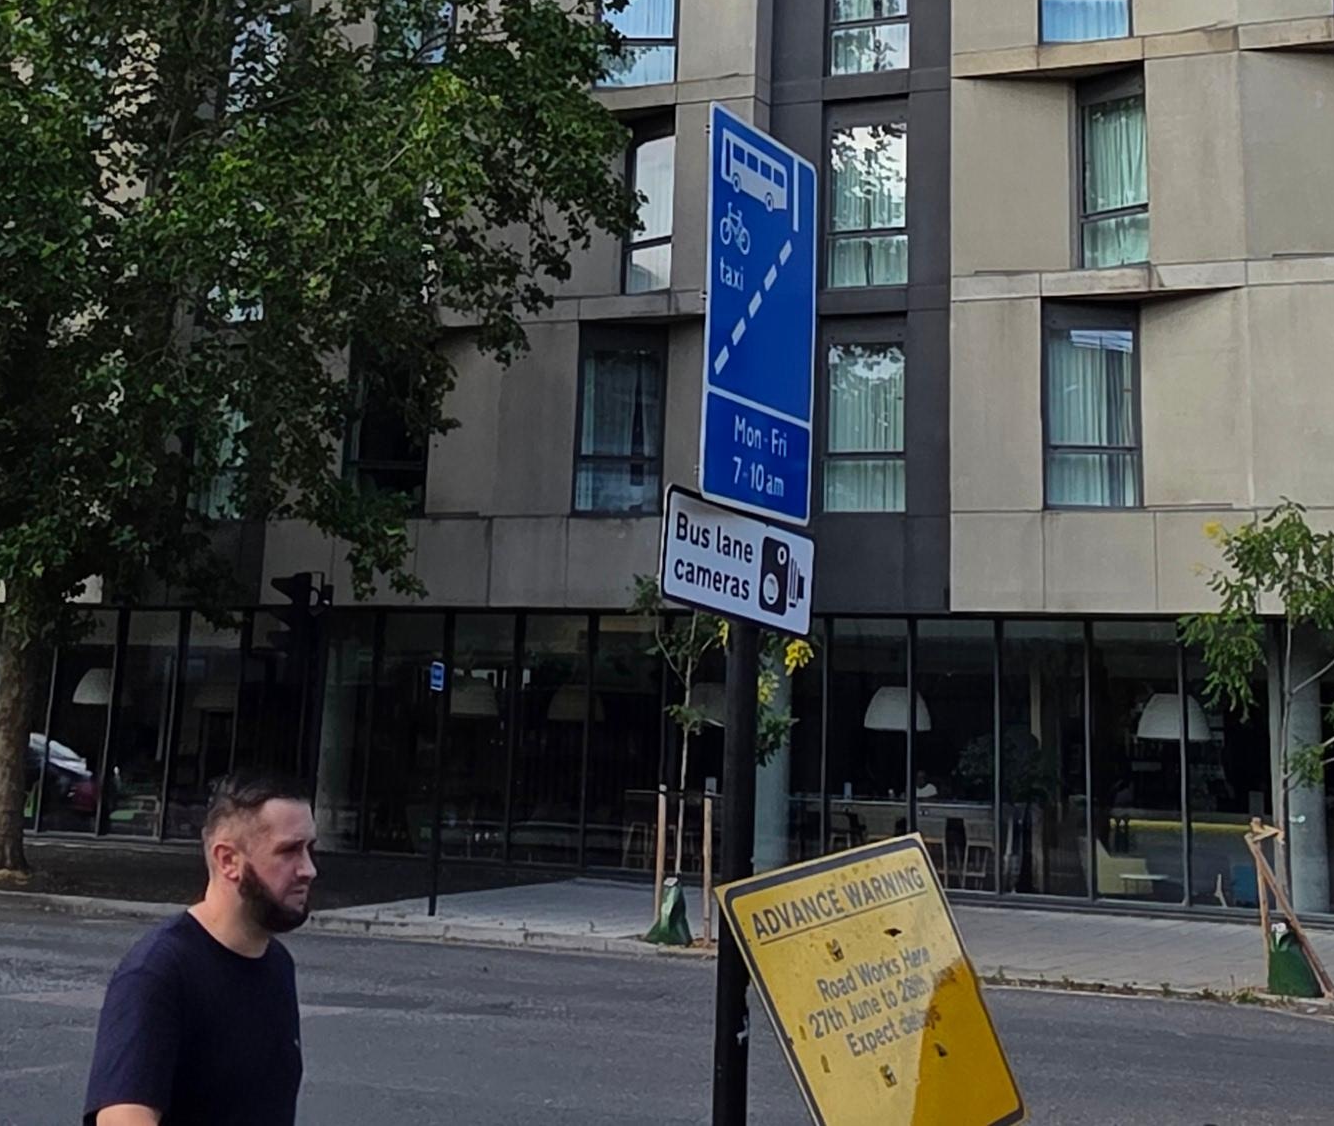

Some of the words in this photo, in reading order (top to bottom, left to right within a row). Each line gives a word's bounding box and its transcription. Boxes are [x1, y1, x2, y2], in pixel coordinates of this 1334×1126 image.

[720, 256, 744, 292] taxi
[676, 511, 711, 549] Bus
[717, 525, 753, 564] lane
[674, 558, 750, 601] cameras
[751, 888, 846, 940] ADVANCE
[842, 866, 925, 910] WARNING
[817, 969, 858, 1002] Road
[854, 956, 901, 988] Works
[809, 1005, 848, 1039] 27th
[847, 996, 882, 1024] June
[879, 987, 899, 1010] to
[845, 1016, 900, 1057] Expect
